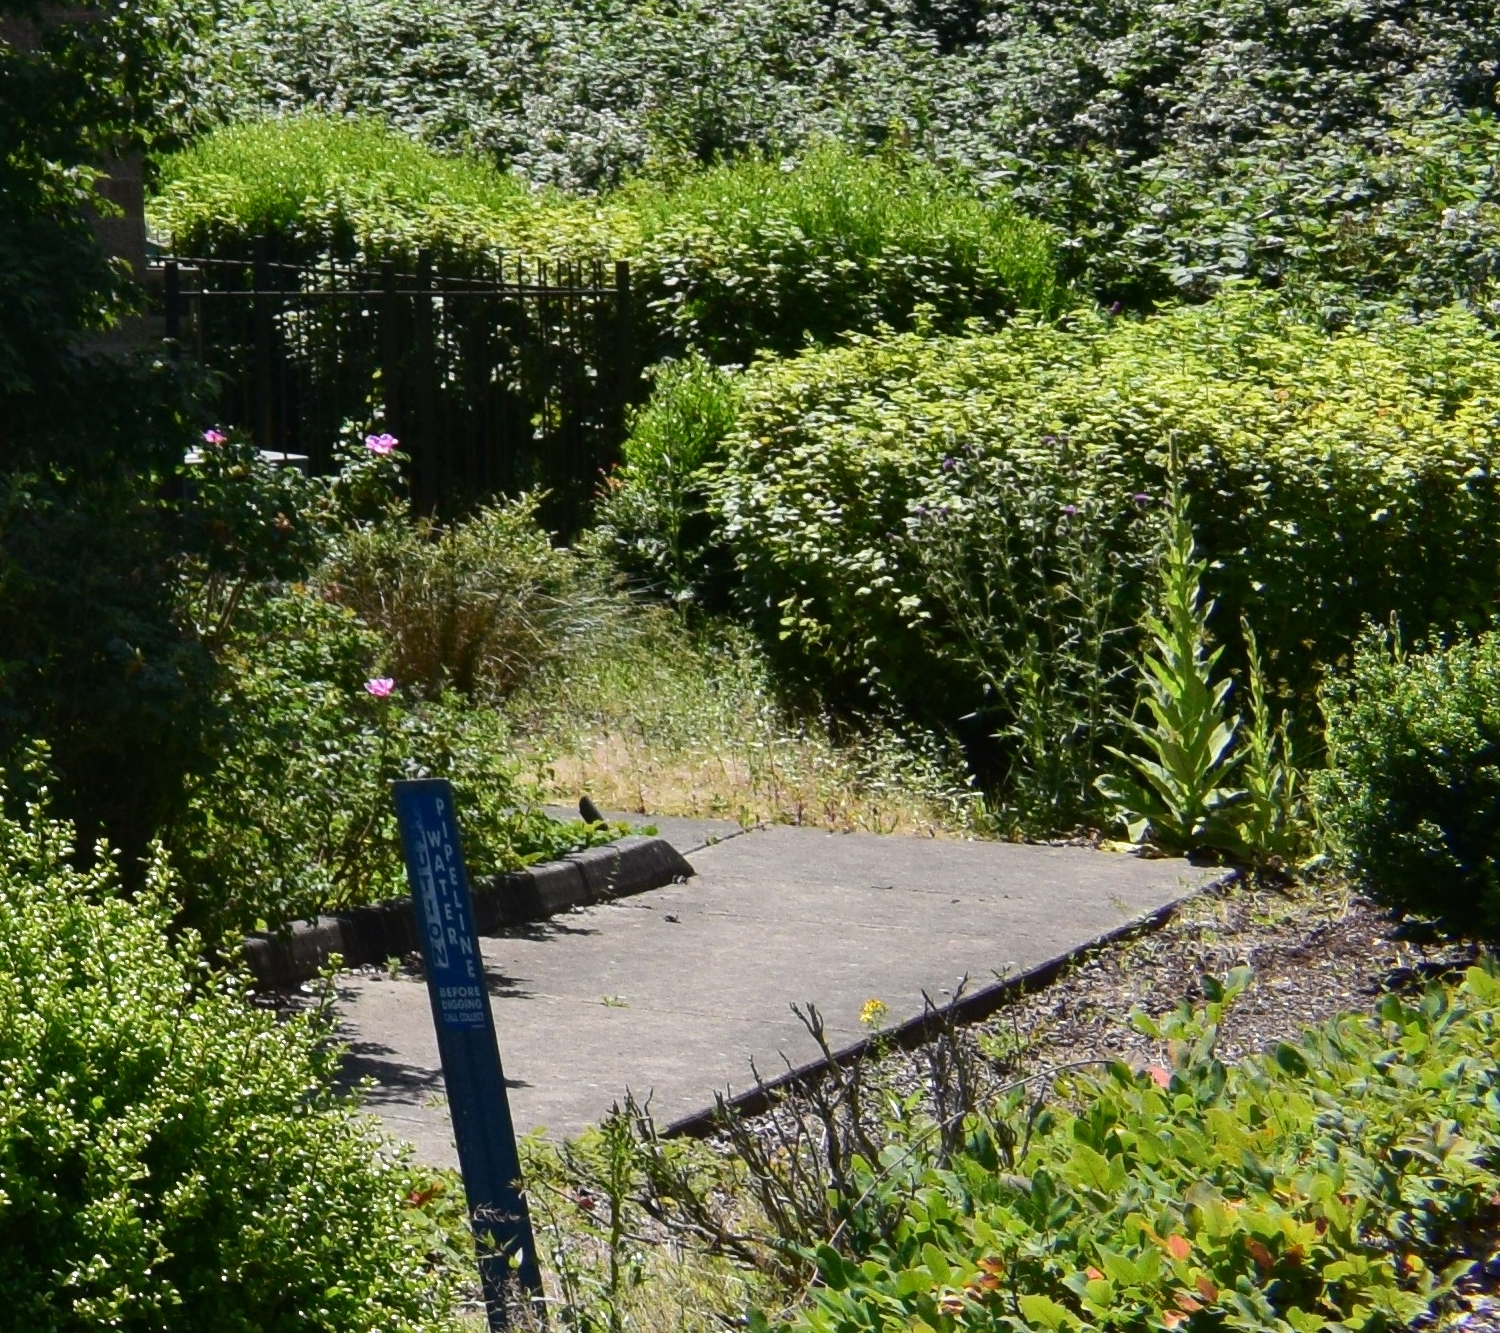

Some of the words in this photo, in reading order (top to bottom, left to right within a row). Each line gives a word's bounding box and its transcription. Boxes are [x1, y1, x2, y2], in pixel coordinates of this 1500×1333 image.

[426, 830, 458, 945] WATER
[435, 797, 476, 978] PIPELINE
[439, 986, 480, 998] BEFORE
